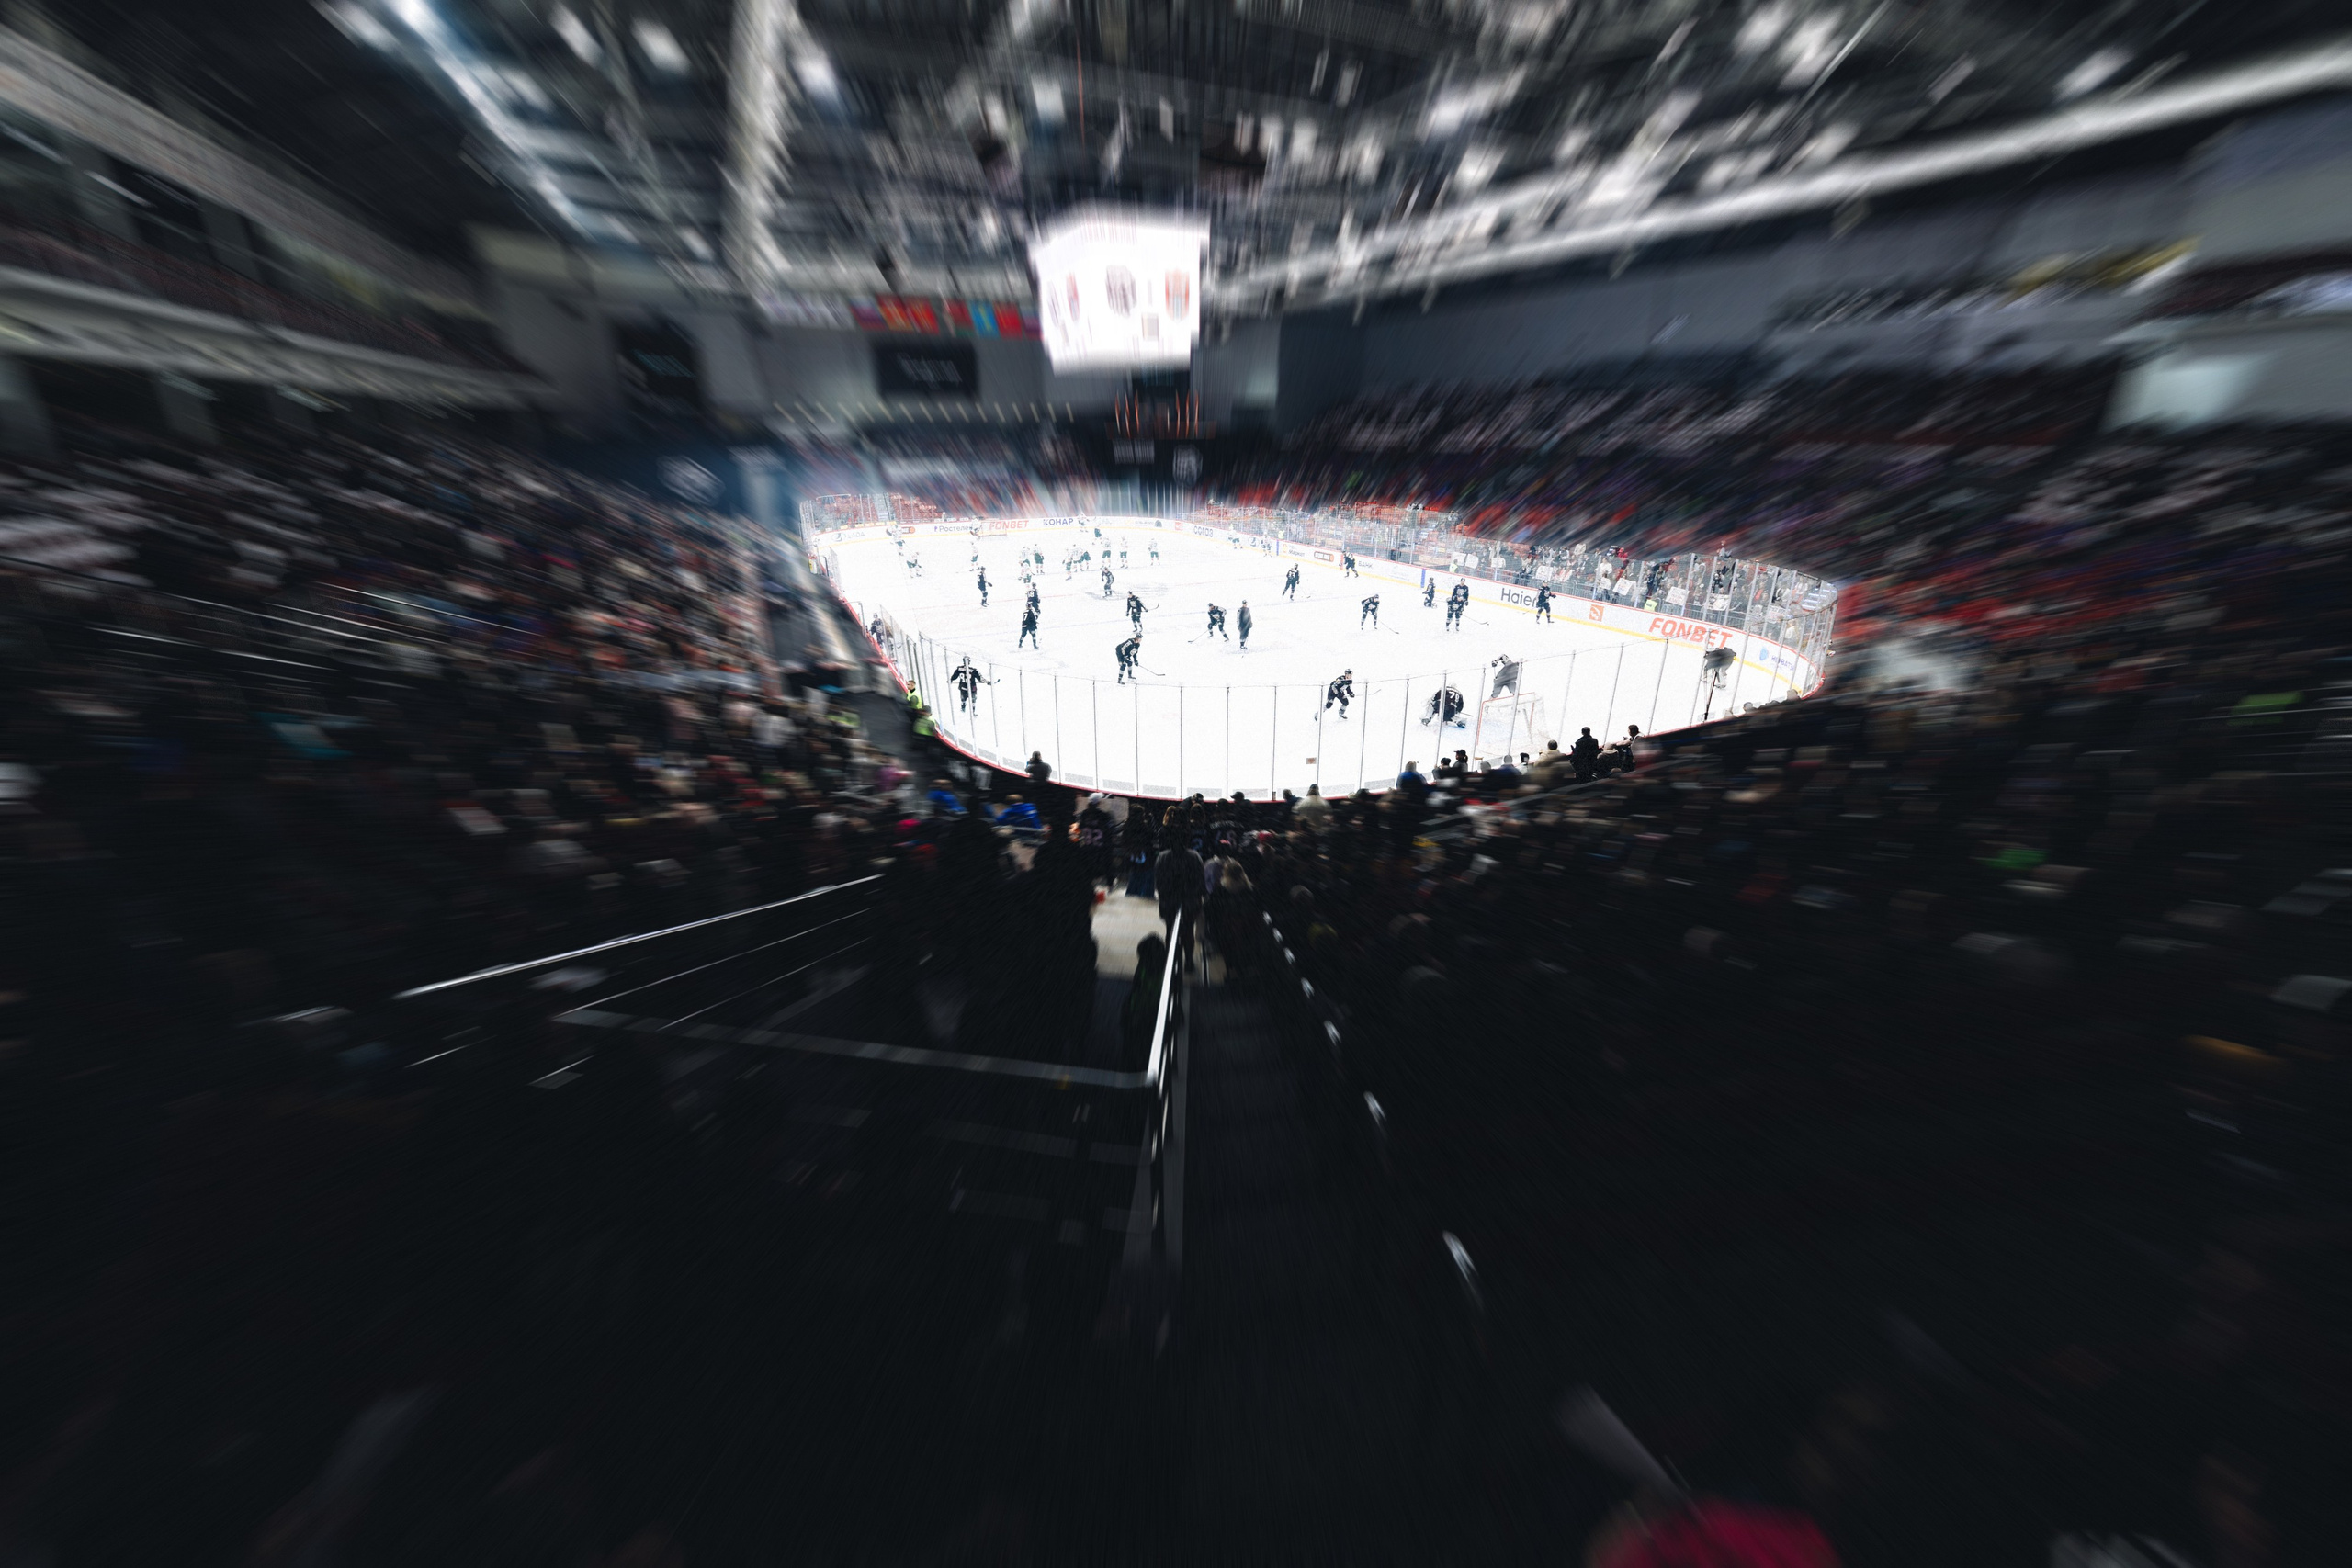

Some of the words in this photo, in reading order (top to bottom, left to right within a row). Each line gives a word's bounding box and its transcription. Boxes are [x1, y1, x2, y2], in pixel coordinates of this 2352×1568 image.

[989, 519, 1029, 530] FONBET
[1500, 587, 1537, 608] Haier
[1649, 617, 1733, 649] FONBET
